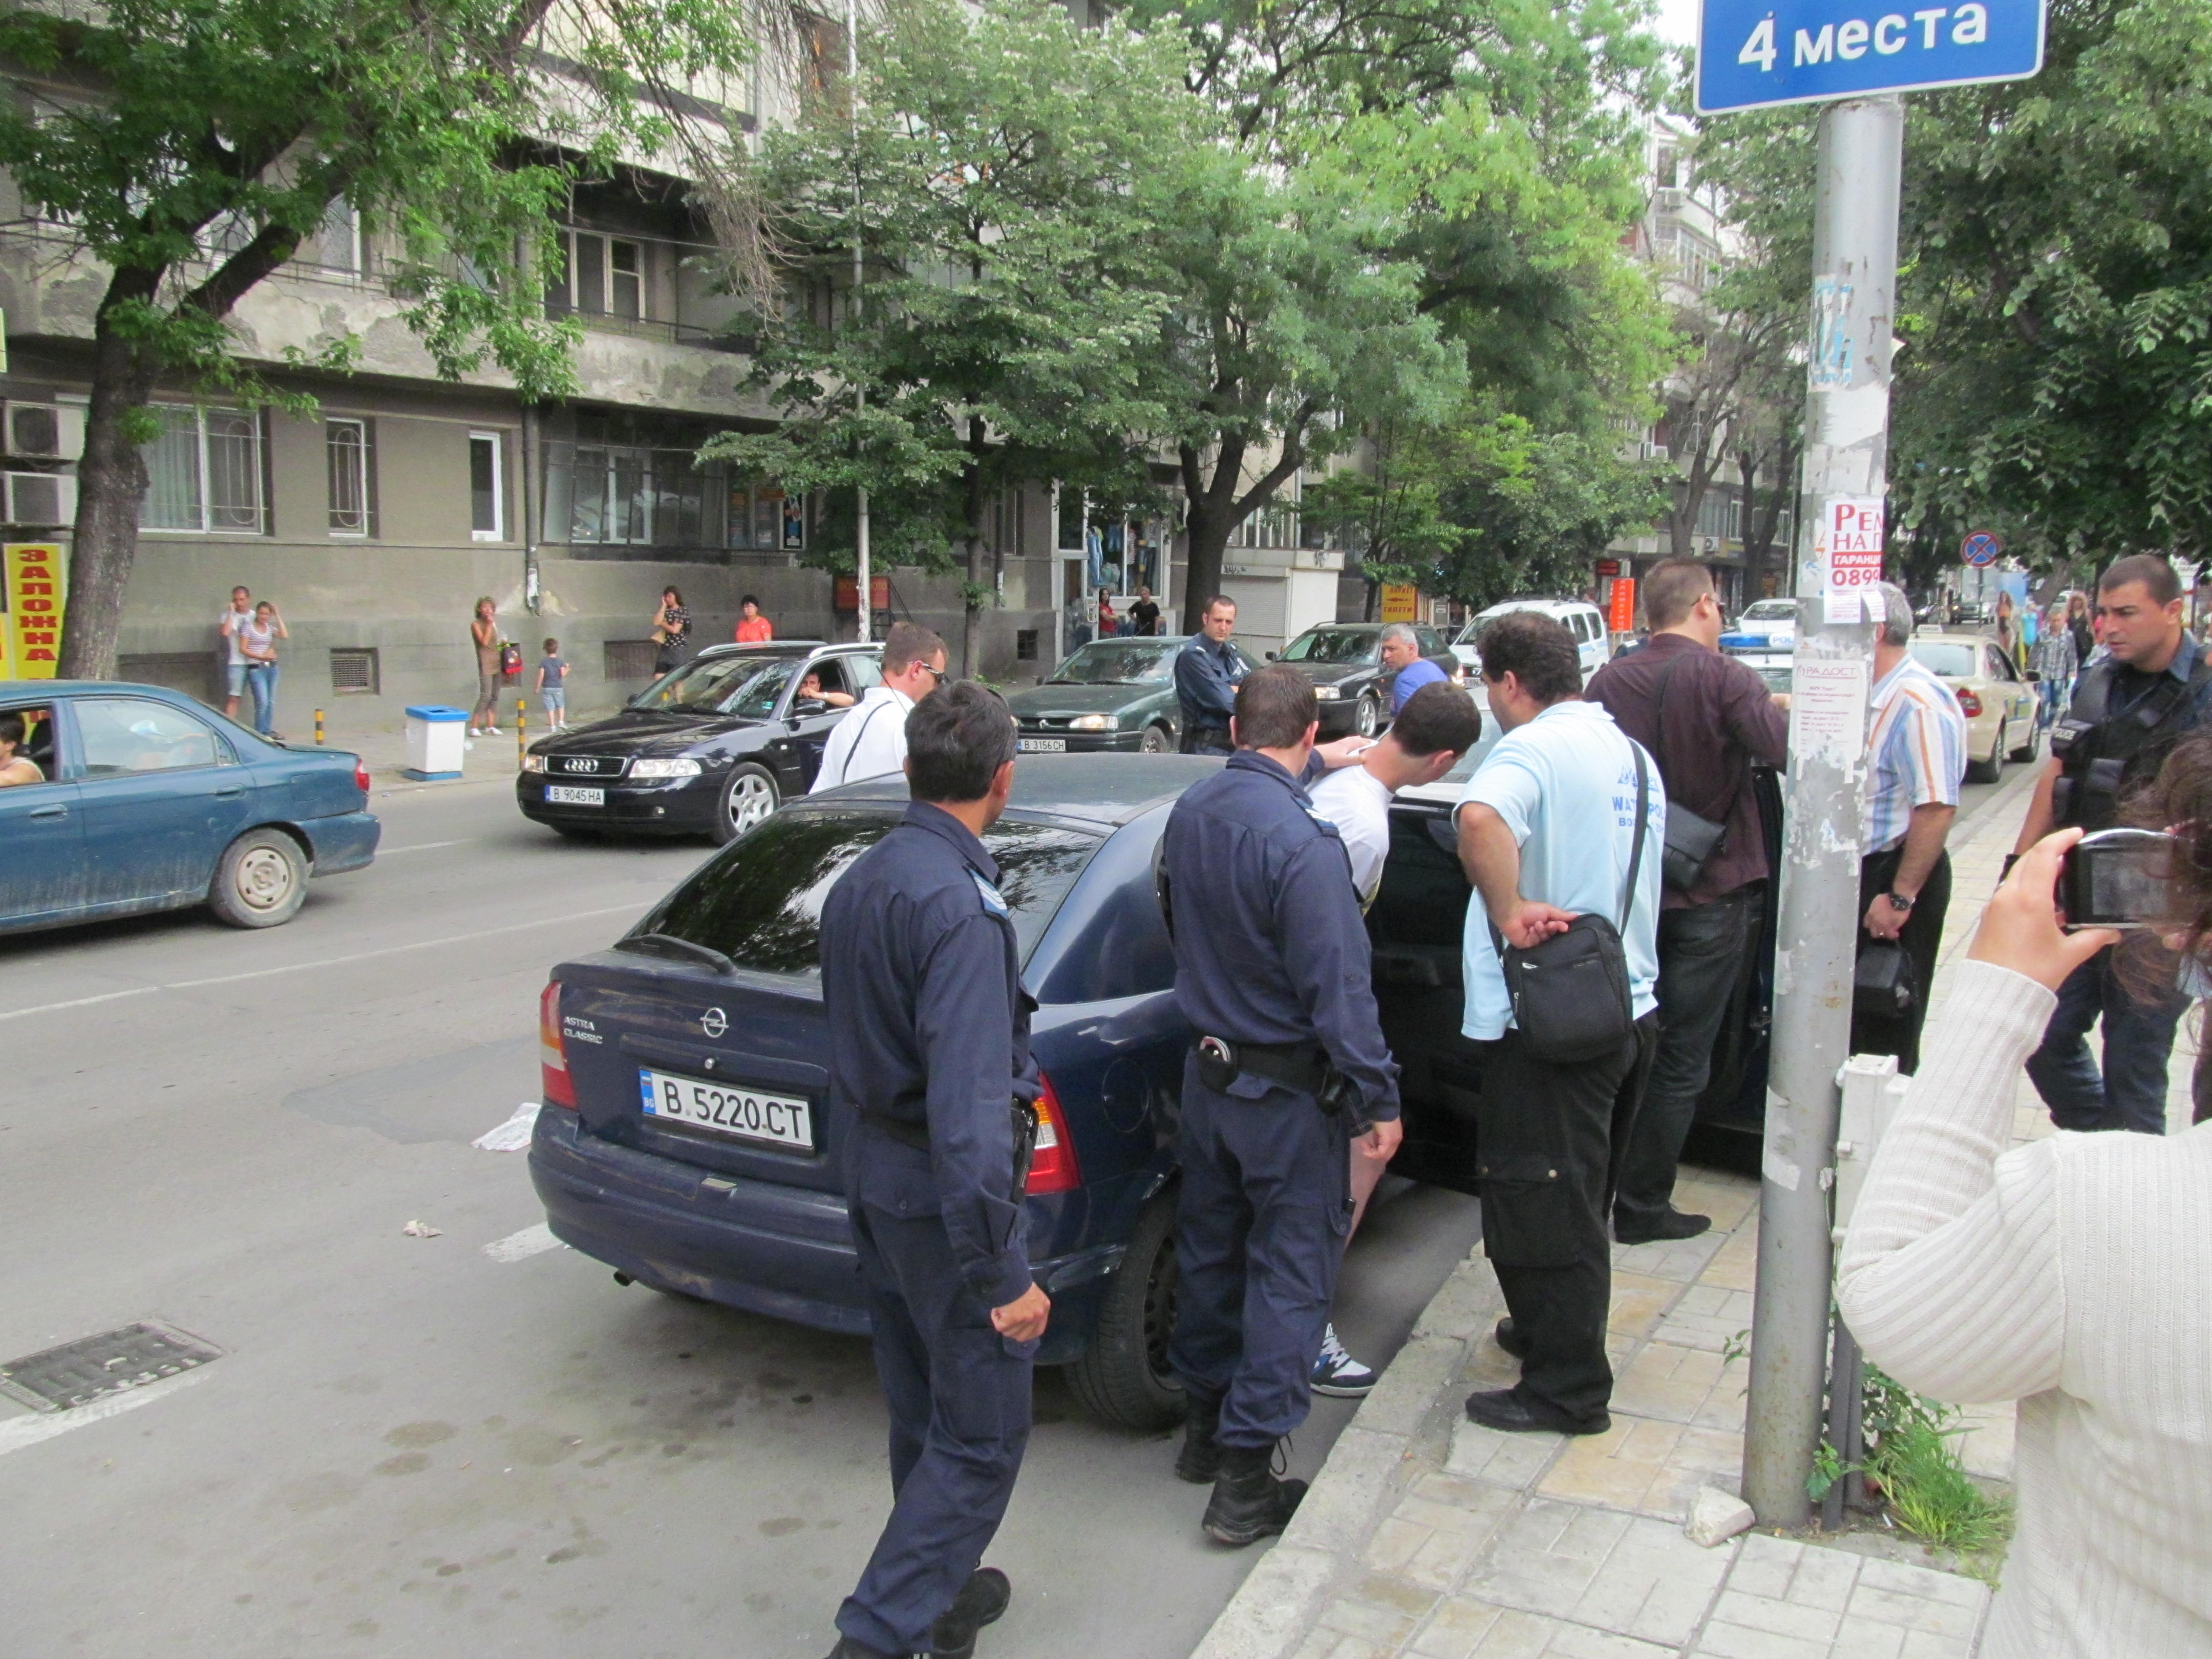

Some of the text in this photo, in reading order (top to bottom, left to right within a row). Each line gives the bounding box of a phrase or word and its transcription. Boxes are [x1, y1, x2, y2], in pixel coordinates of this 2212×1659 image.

[1738, 3, 1986, 72] 4 места
[1834, 533, 1867, 549] НА
[1832, 569, 1879, 586] 0899
[18, 549, 57, 661] ЗАЛОЖНА
[1806, 667, 1857, 676] РАДОСТ
[564, 789, 586, 802] 9045
[564, 1016, 594, 1031] ASTRA
[564, 1028, 603, 1045] CLASSIC
[693, 1087, 760, 1131] 5220
[766, 1101, 802, 1139] CT
